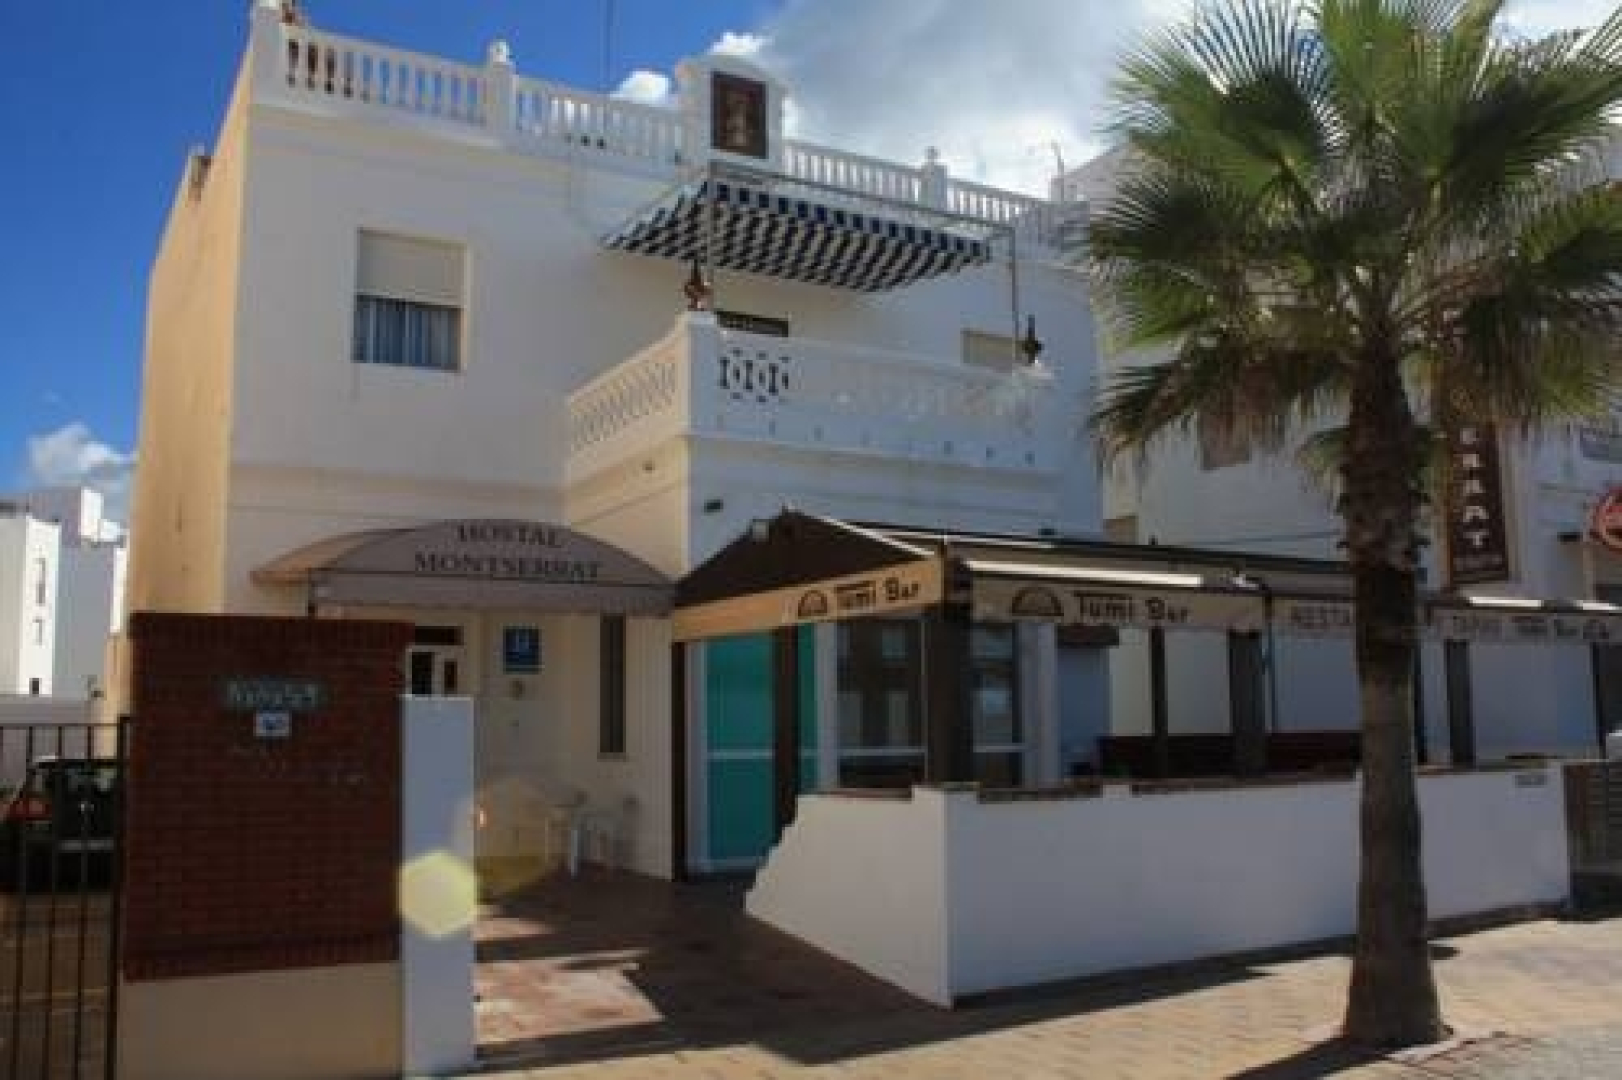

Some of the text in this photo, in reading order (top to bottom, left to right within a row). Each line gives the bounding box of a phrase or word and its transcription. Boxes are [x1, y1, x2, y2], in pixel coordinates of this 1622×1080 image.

[458, 523, 562, 549] HOSTAL
[414, 553, 601, 584] MONTSERRAT
[1072, 589, 1189, 623] Tumi Bar
